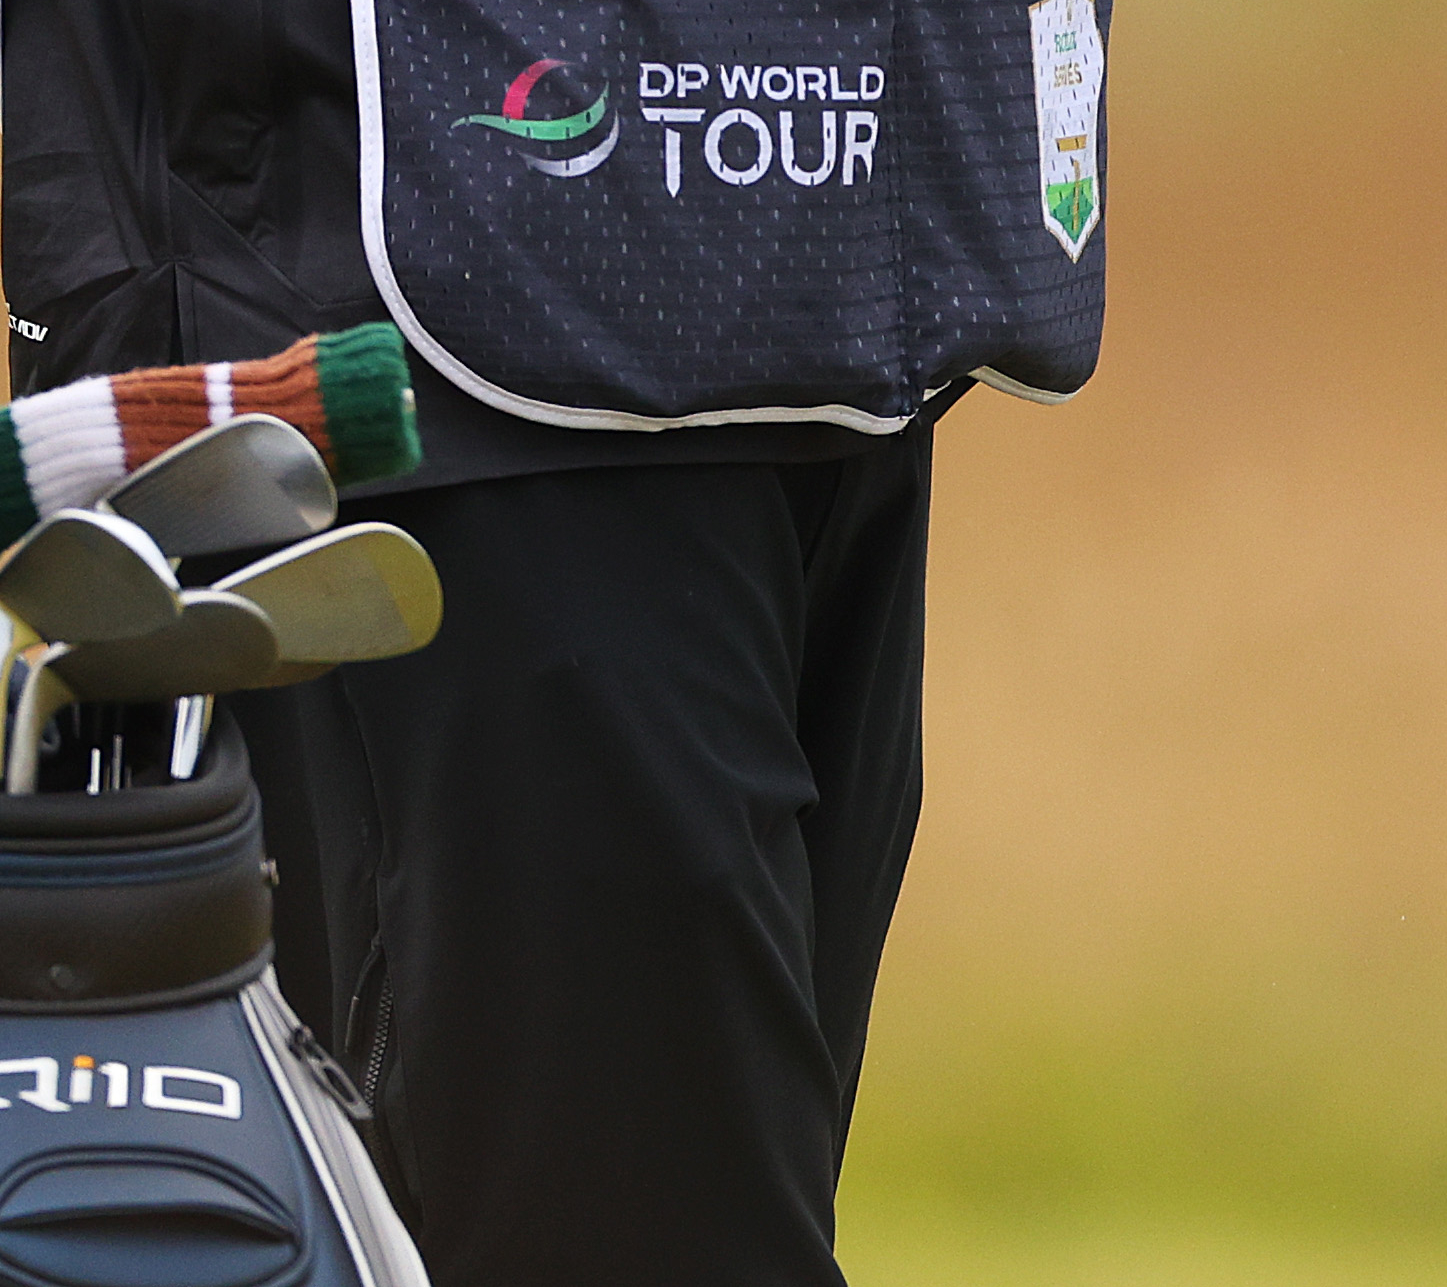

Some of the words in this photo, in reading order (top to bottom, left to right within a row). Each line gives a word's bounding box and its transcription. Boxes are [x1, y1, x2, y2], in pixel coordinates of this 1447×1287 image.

[640, 63, 709, 98] DP
[721, 64, 885, 101] WORLD
[642, 107, 879, 198] TOUR
